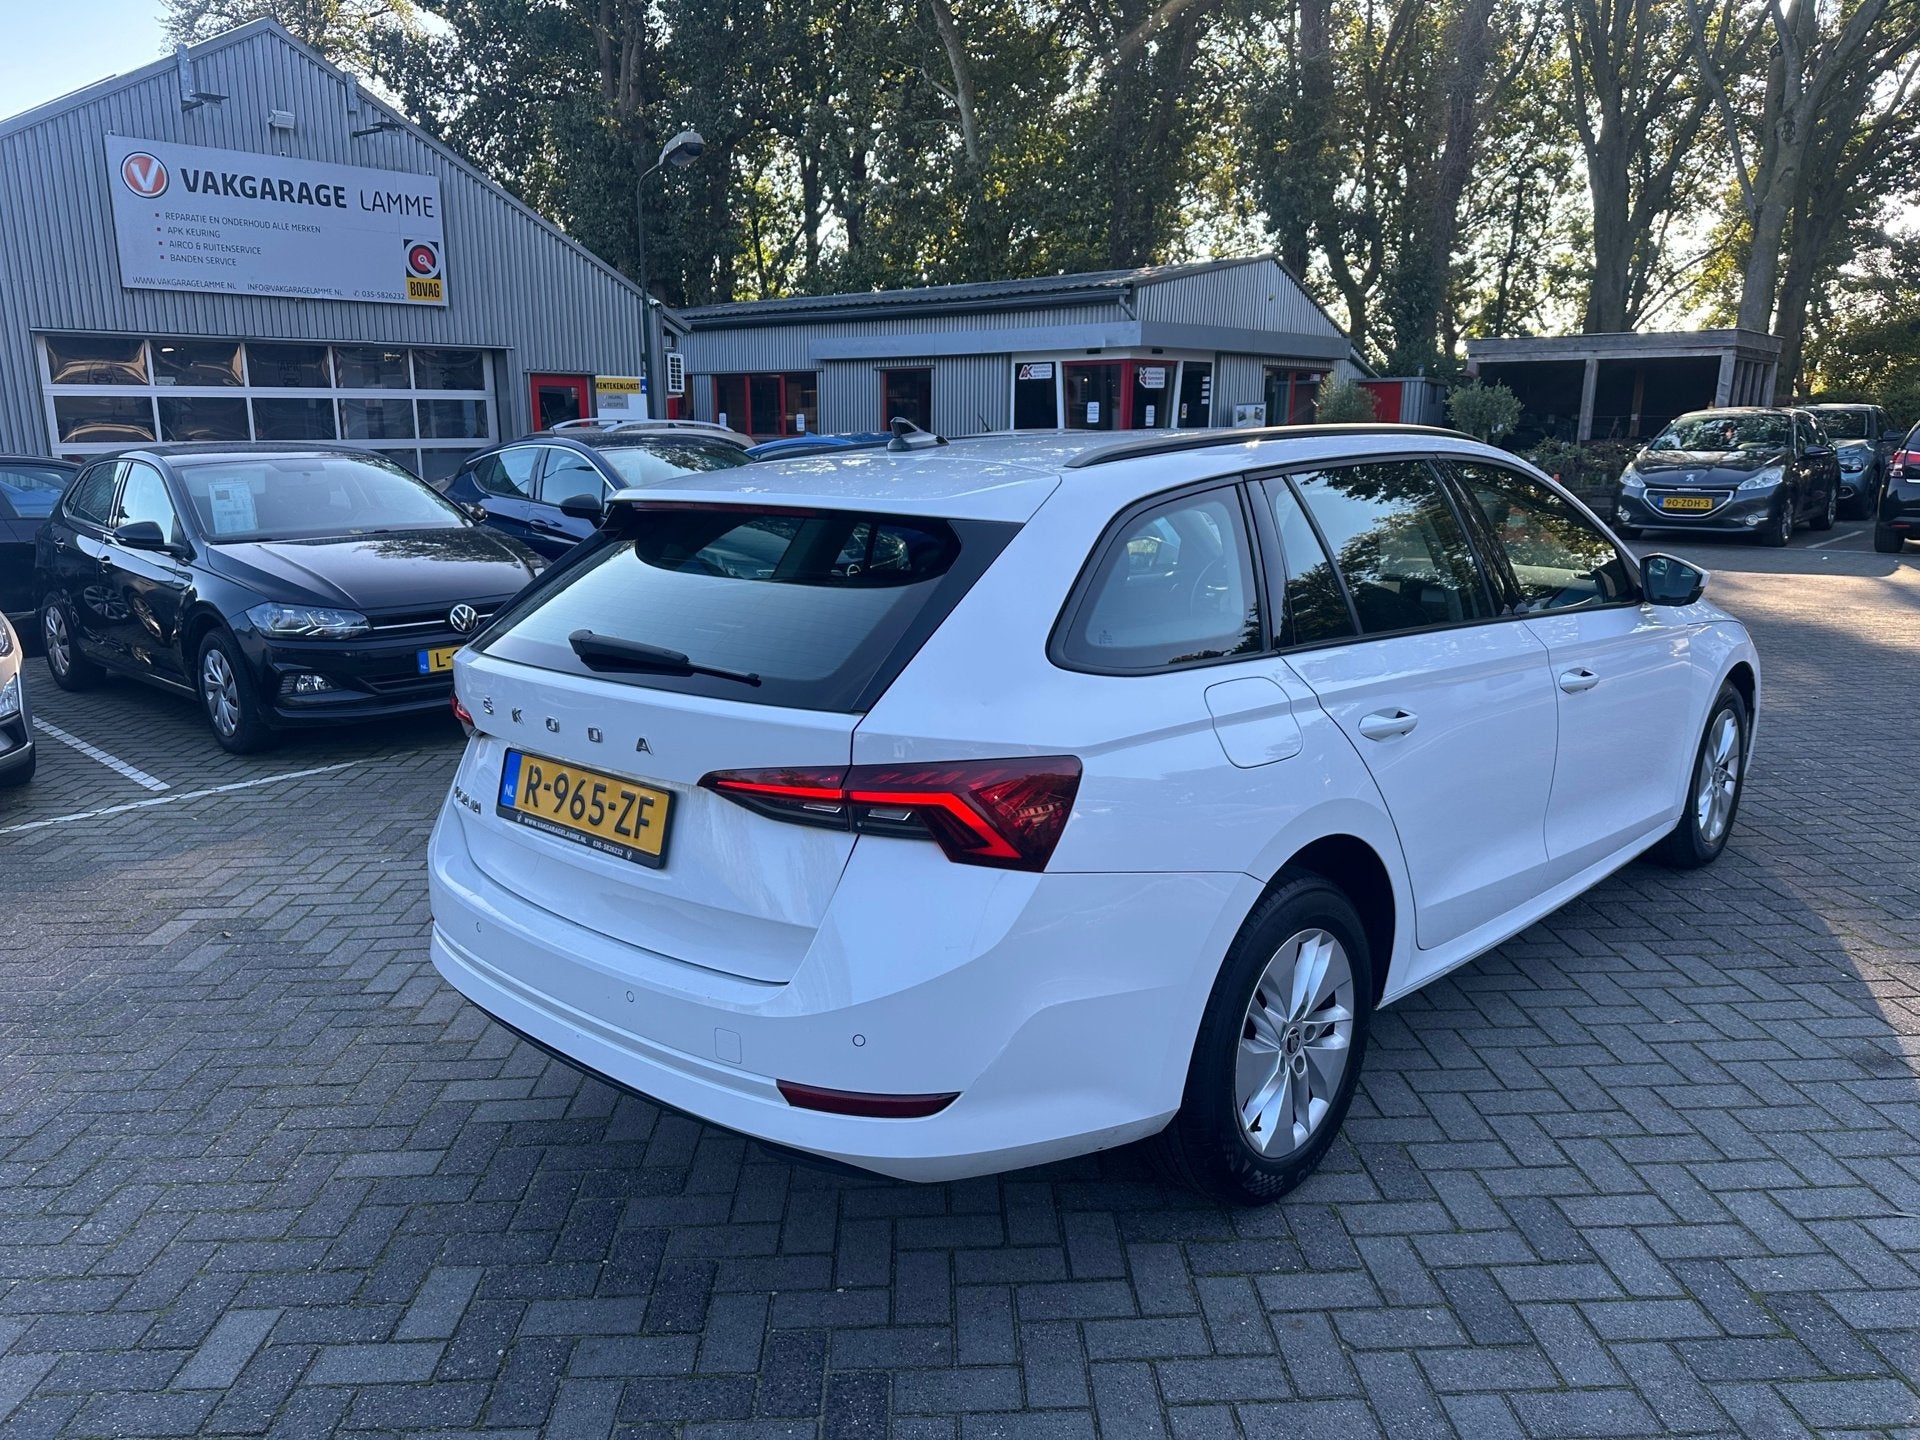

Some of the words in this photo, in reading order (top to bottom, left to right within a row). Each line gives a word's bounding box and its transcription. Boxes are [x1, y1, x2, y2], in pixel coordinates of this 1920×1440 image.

[180, 168, 347, 209] VAKGARAGE
[360, 189, 435, 218] LAMME
[165, 212, 206, 223] REPARATIE
[209, 216, 220, 225] EN
[222, 217, 271, 229] ONDERHOUD
[272, 222, 290, 231] ALLE
[291, 224, 321, 234] MERKEN
[167, 226, 183, 235] APK
[186, 228, 221, 239] KEURING
[169, 241, 194, 250] AIRCO
[203, 243, 262, 255] RUITENSERVICE
[170, 254, 204, 264] BANDEN
[206, 256, 237, 266] SERVICE
[409, 281, 440, 298] BOVAG
[596, 382, 640, 390] KENTEKENLOKET
[1665, 498, 1710, 508] 90-ZDH-3
[436, 649, 459, 668] L-
[504, 783, 515, 798] NL
[523, 763, 655, 840] R-965-ZF
